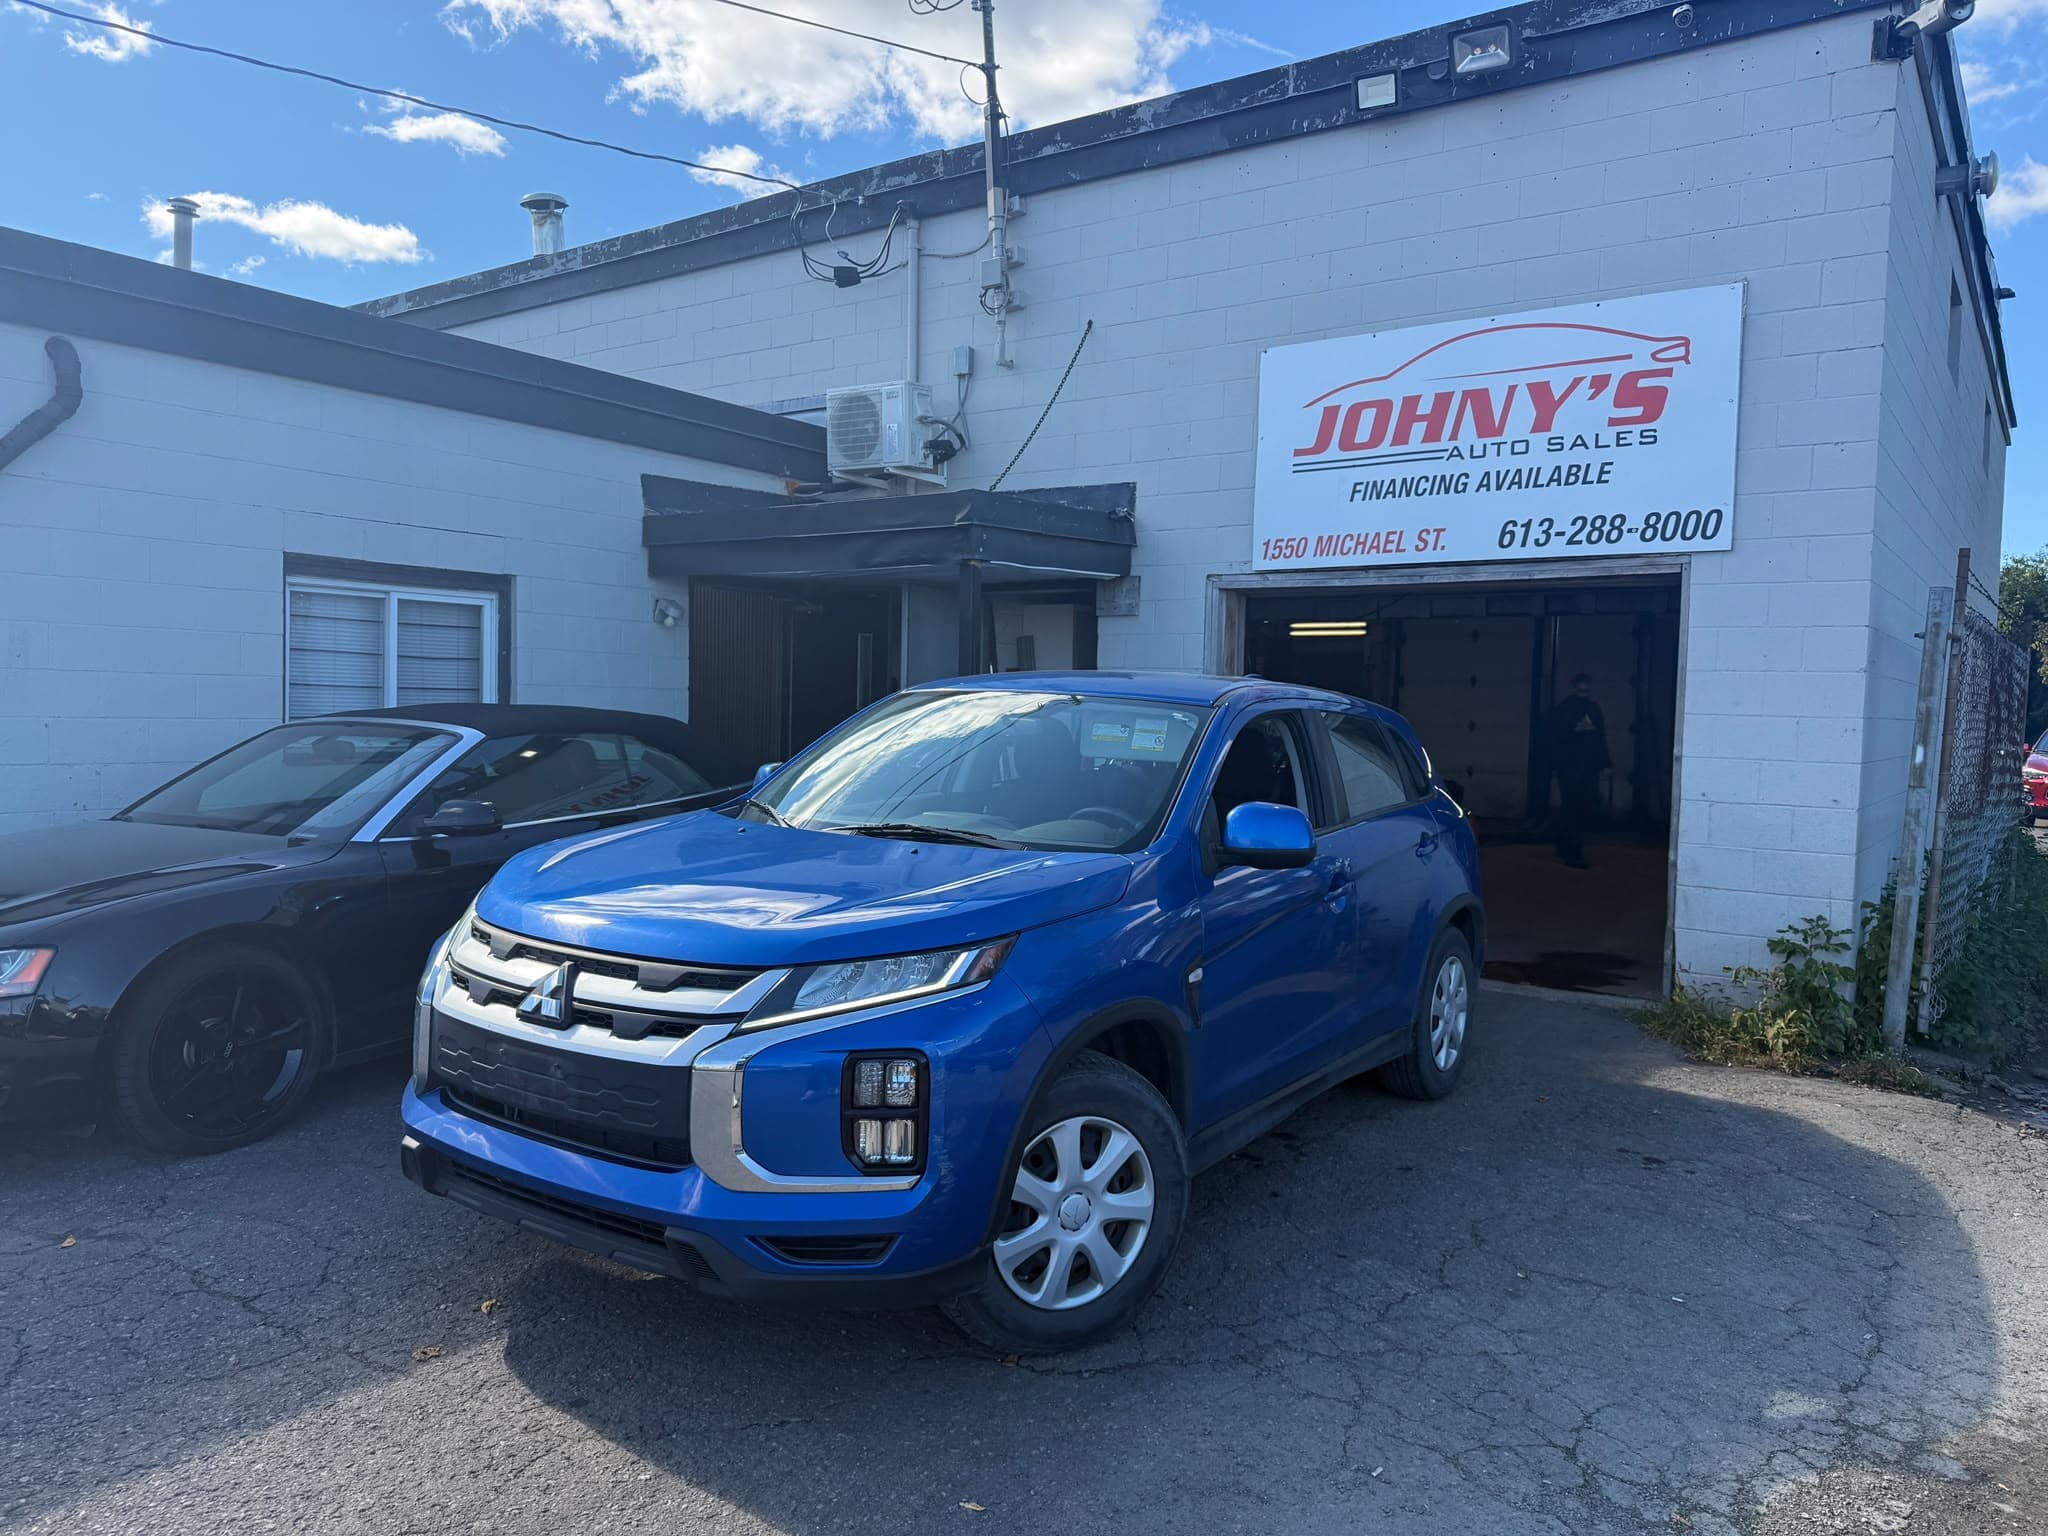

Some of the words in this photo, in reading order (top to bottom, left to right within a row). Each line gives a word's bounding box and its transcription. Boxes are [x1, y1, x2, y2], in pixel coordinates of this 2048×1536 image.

[1293, 366, 1674, 457] JOHNY'S
[1446, 439, 1530, 461] AUTO
[1547, 428, 1659, 452] SALES
[1350, 473, 1470, 503] FINANCING
[1475, 462, 1614, 493] AVAILABLE
[1262, 536, 1309, 561] 1550
[1313, 532, 1407, 558] MICHAEL
[1414, 528, 1447, 554] ST.
[1498, 508, 1724, 549] 613-288-8000
